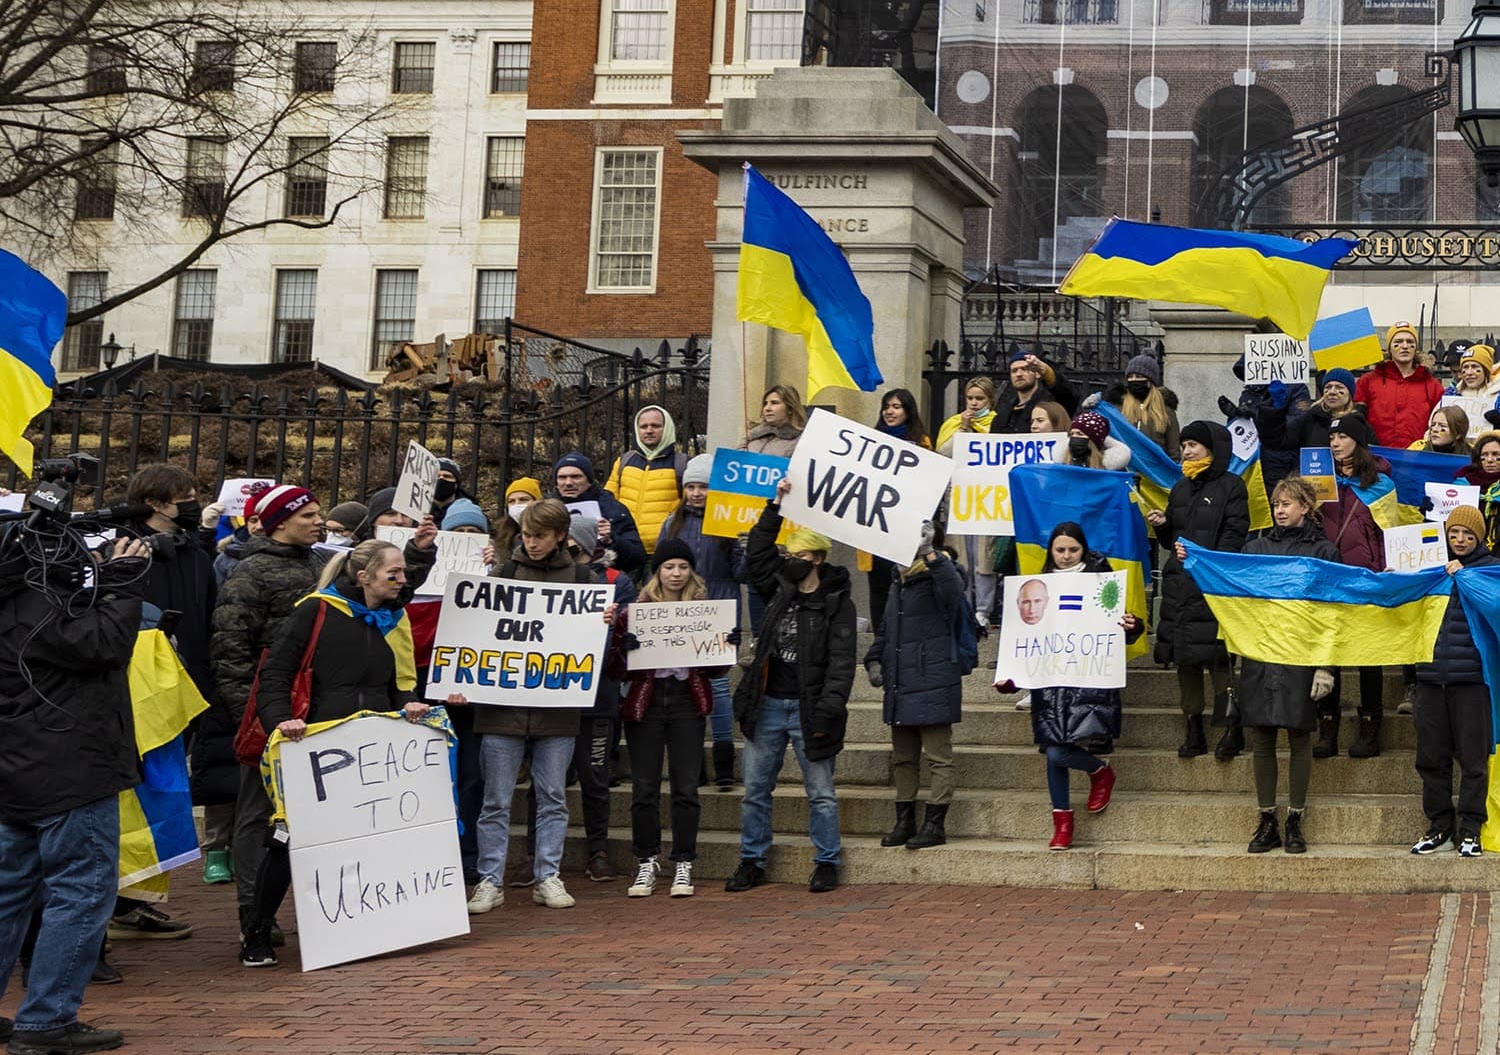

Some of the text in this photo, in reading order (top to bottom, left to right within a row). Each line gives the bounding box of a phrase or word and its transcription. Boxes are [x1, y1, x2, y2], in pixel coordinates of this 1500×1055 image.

[1247, 360, 1308, 381] SPEAK UP
[829, 429, 920, 476] STOP
[967, 440, 1057, 466] SUPPORT
[723, 460, 783, 486] STOP
[807, 458, 901, 534] WAR
[713, 504, 732, 521] IN
[1398, 547, 1447, 570] PEACE
[454, 580, 534, 615] CANT
[541, 588, 607, 615] TAKE
[635, 608, 668, 621] EVERY
[494, 618, 545, 642] OUR
[690, 631, 735, 659] WAR
[1015, 632, 1117, 658] HANDS OFF
[431, 645, 594, 691] FREEDOM
[309, 738, 444, 802] PEACE
[353, 790, 420, 829] TO
